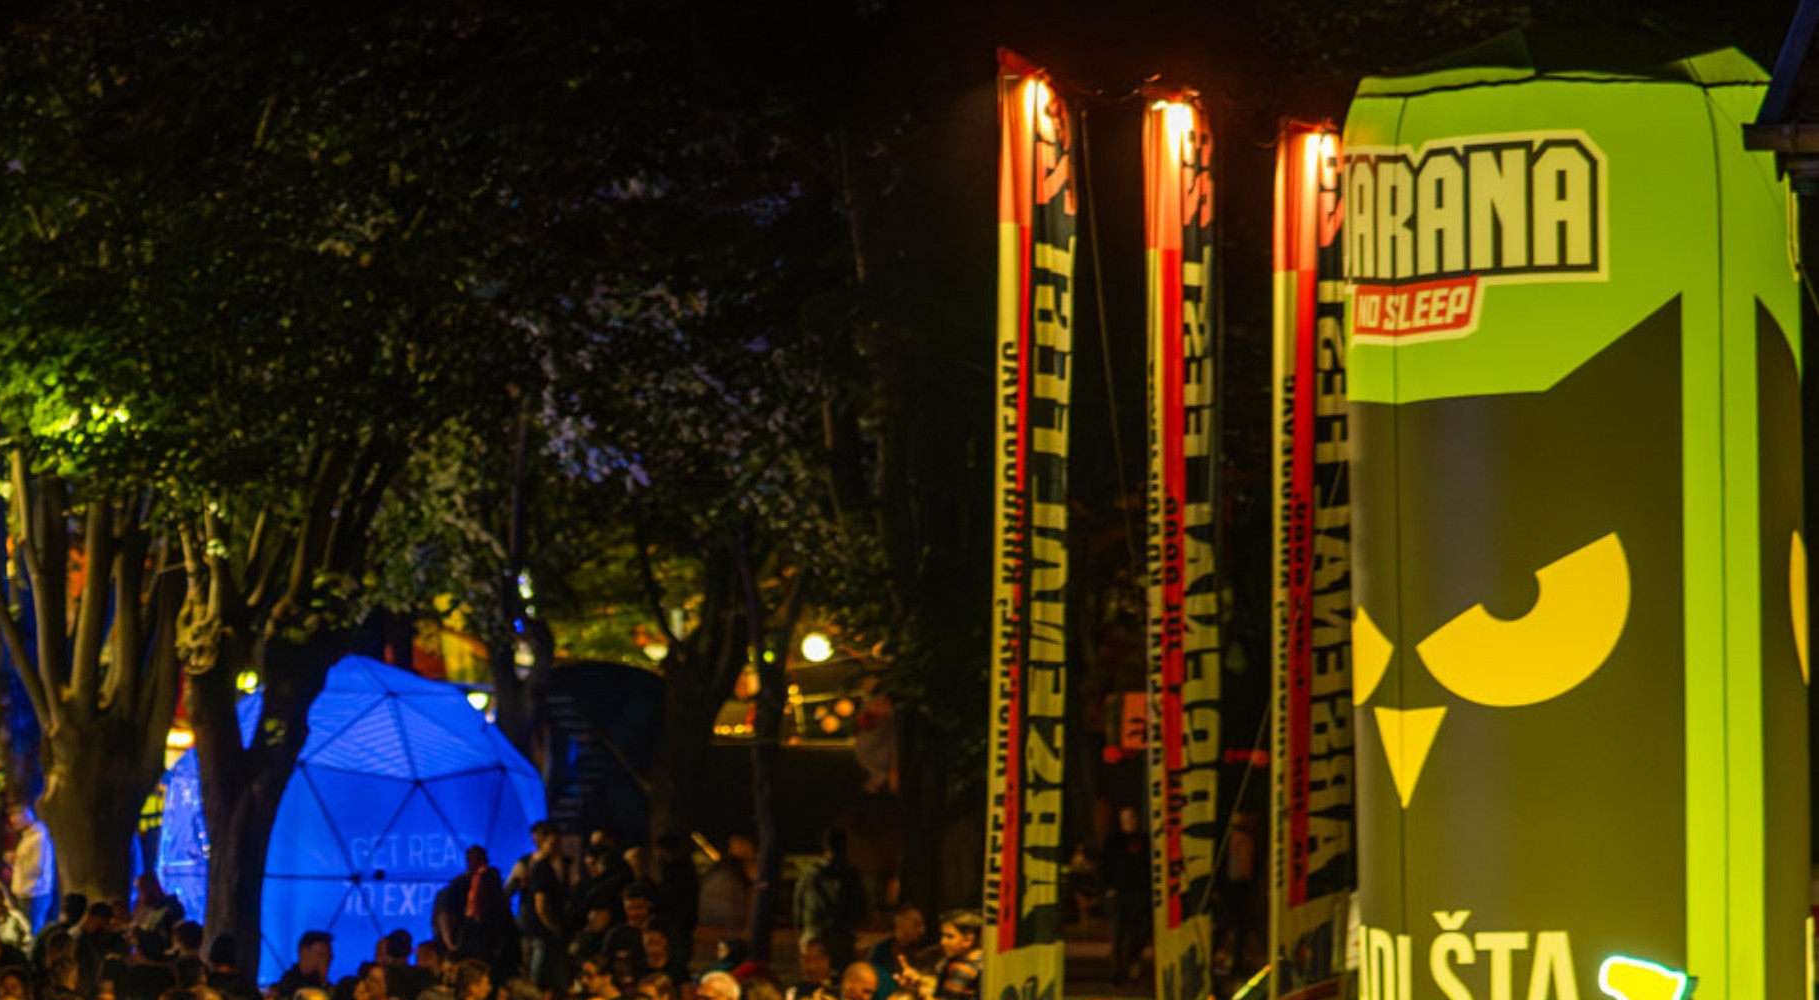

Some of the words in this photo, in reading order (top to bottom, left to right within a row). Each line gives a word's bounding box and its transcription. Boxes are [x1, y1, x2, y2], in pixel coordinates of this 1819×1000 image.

[1357, 294, 1381, 329] NO
[1383, 285, 1472, 331] SLEEP
[383, 881, 446, 916] EXP
